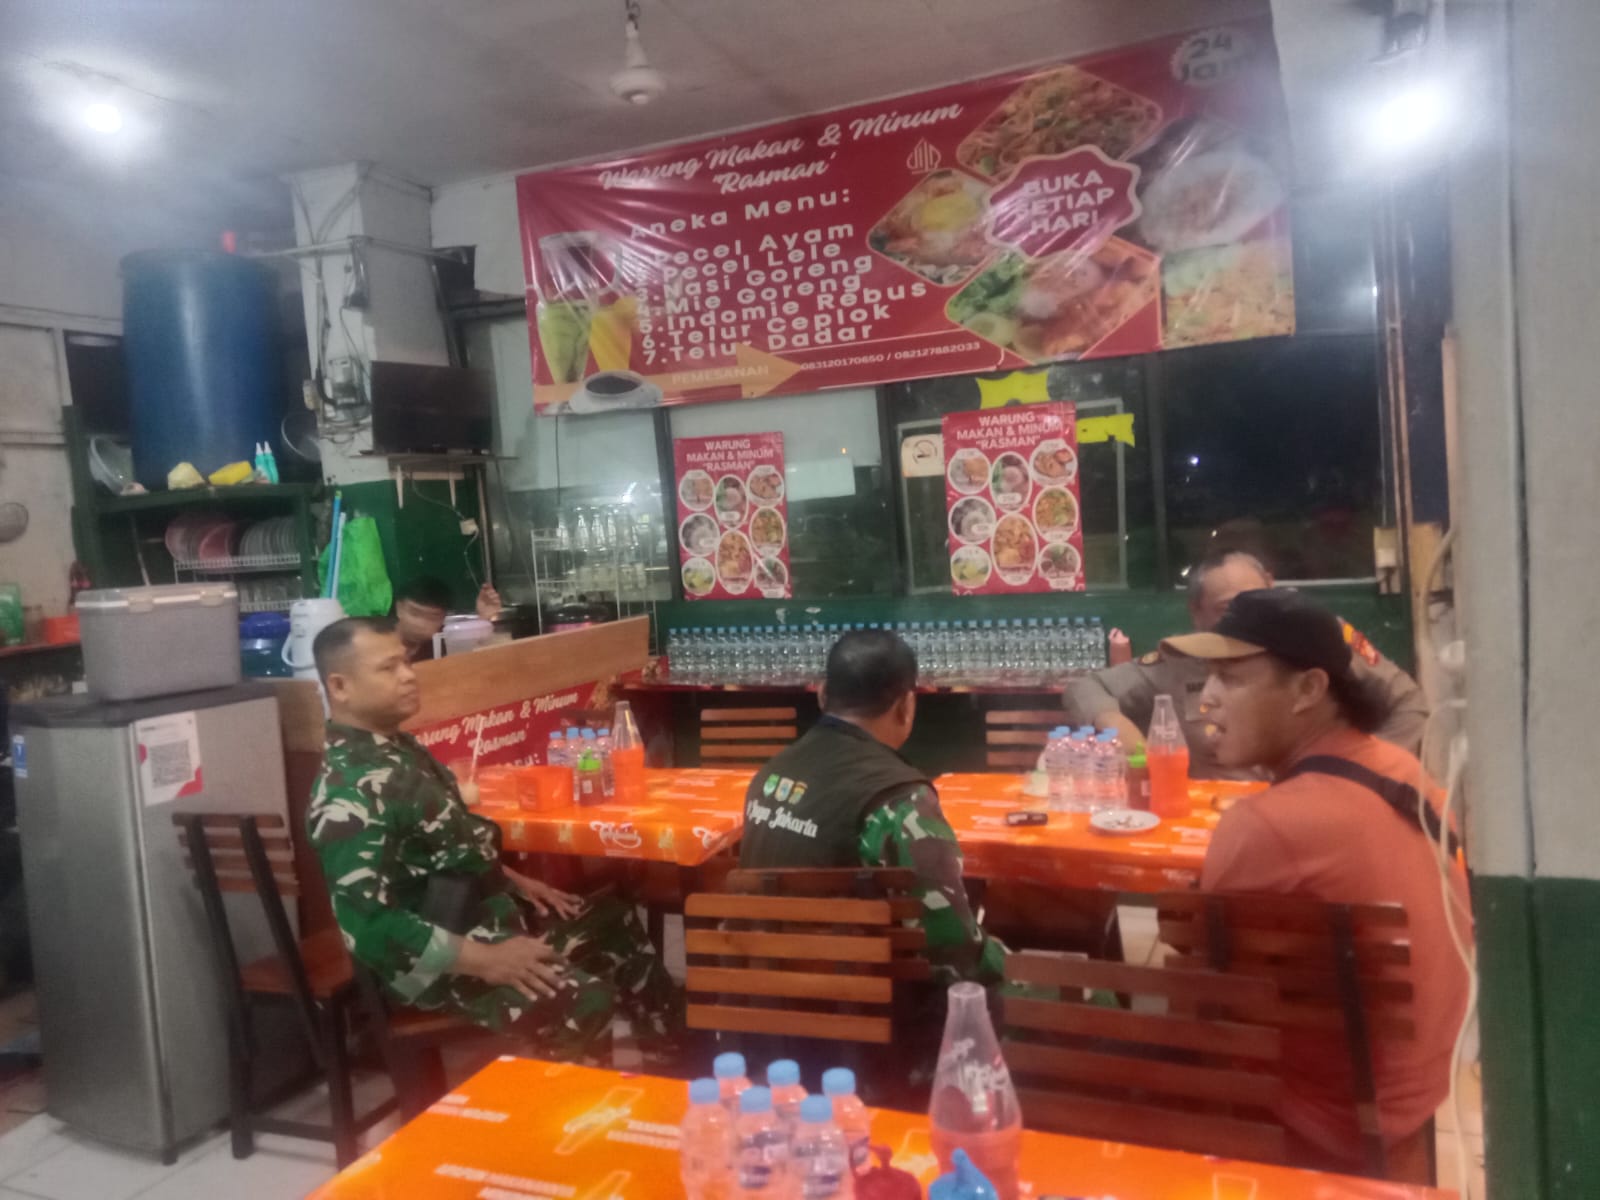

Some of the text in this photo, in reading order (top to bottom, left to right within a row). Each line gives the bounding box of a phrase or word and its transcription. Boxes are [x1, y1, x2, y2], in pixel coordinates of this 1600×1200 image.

[598, 103, 963, 190] Warung Makan & Minum
[1023, 170, 1103, 196] BUKA
[630, 189, 849, 240] Aneka Menu:
[1016, 187, 1114, 217] SETIAP
[1029, 210, 1098, 235] HARI
[759, 223, 854, 252] Ayam
[767, 243, 840, 266] Lele
[746, 254, 872, 286] Goreng
[737, 275, 861, 304] Goreng
[817, 282, 926, 311] Rebus
[767, 303, 890, 334] Ceplok
[767, 325, 872, 350] Dadar
[957, 420, 1063, 440] MAKAN & MINUM
[979, 411, 1036, 427] WARUNG
[704, 439, 750, 451] WARUNG
[976, 434, 1041, 449] "RASMAN"
[686, 448, 774, 462] MAKAN & MINUM
[520, 700, 531, 718] &
[533, 692, 579, 714] Minum
[768, 806, 818, 838] Jakarta
